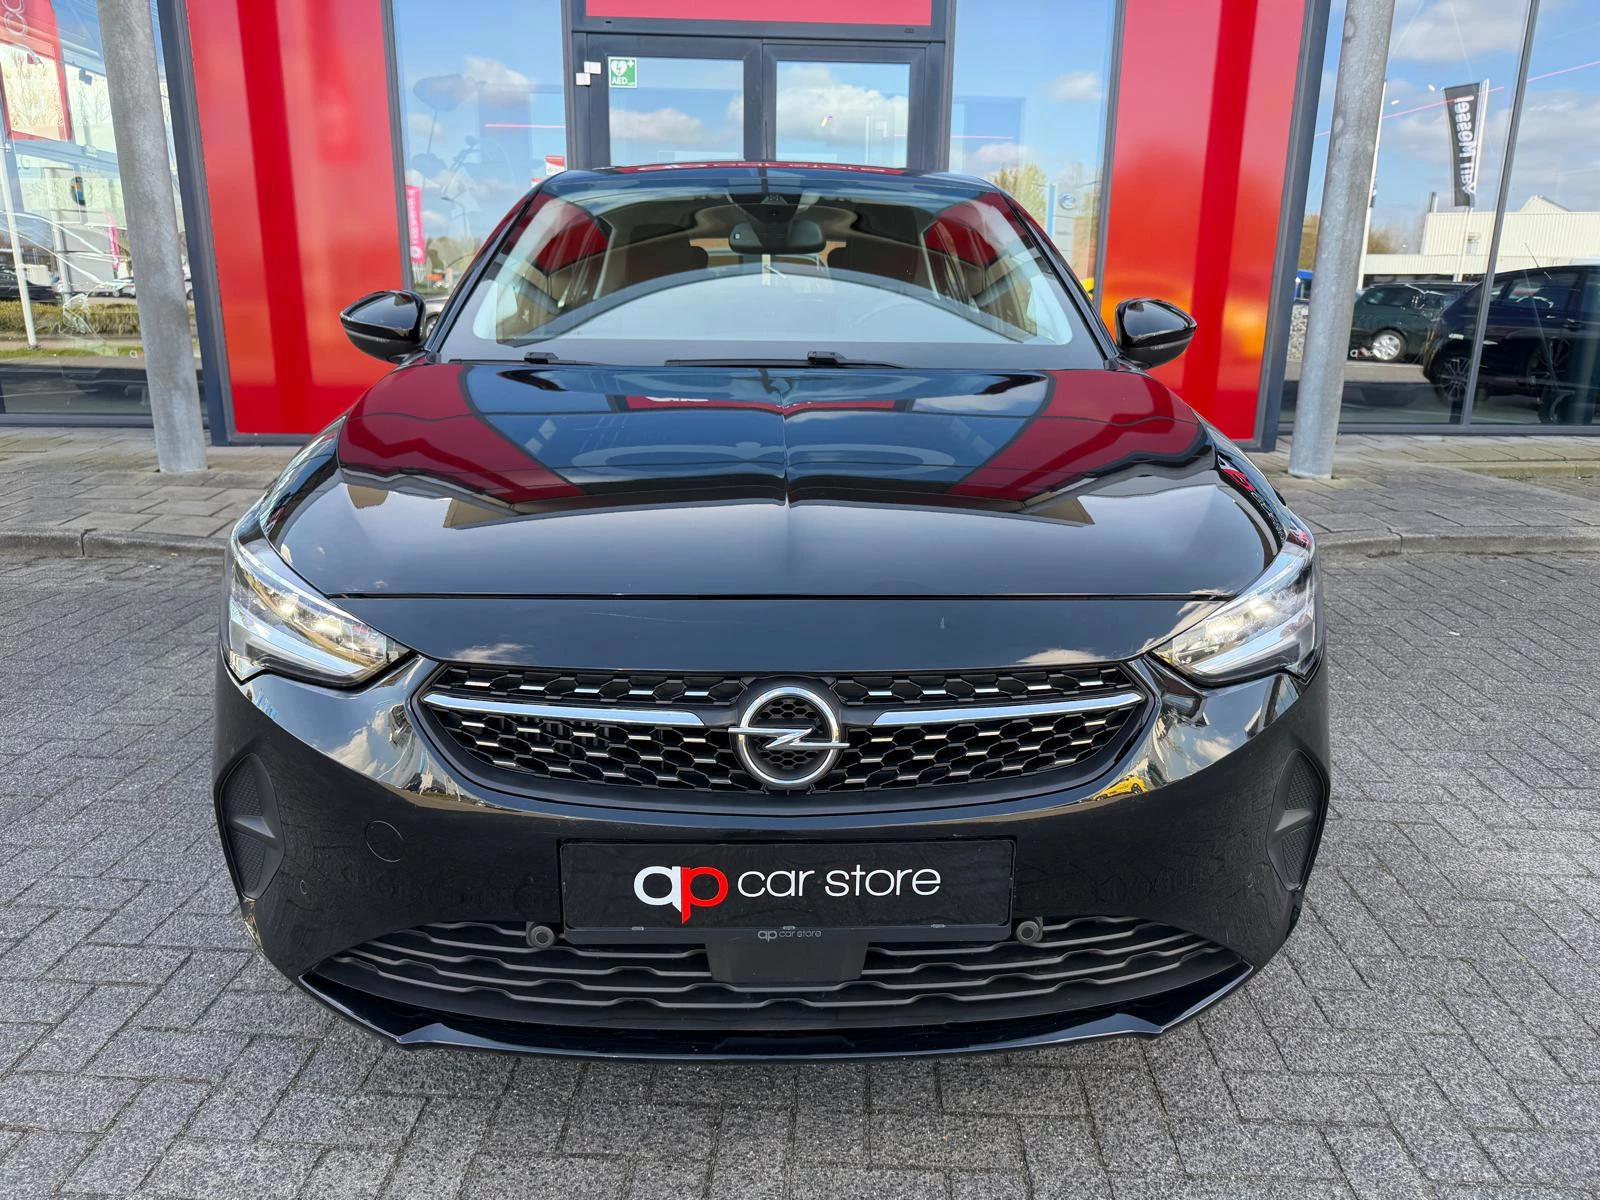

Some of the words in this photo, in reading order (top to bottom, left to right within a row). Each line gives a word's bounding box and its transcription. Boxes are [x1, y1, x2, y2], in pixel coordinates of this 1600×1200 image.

[611, 76, 628, 85] AED
[633, 865, 729, 925] ap
[737, 869, 816, 898] car
[824, 864, 942, 898] store
[757, 930, 778, 942] ap
[778, 930, 796, 938] car
[796, 929, 822, 938] store
